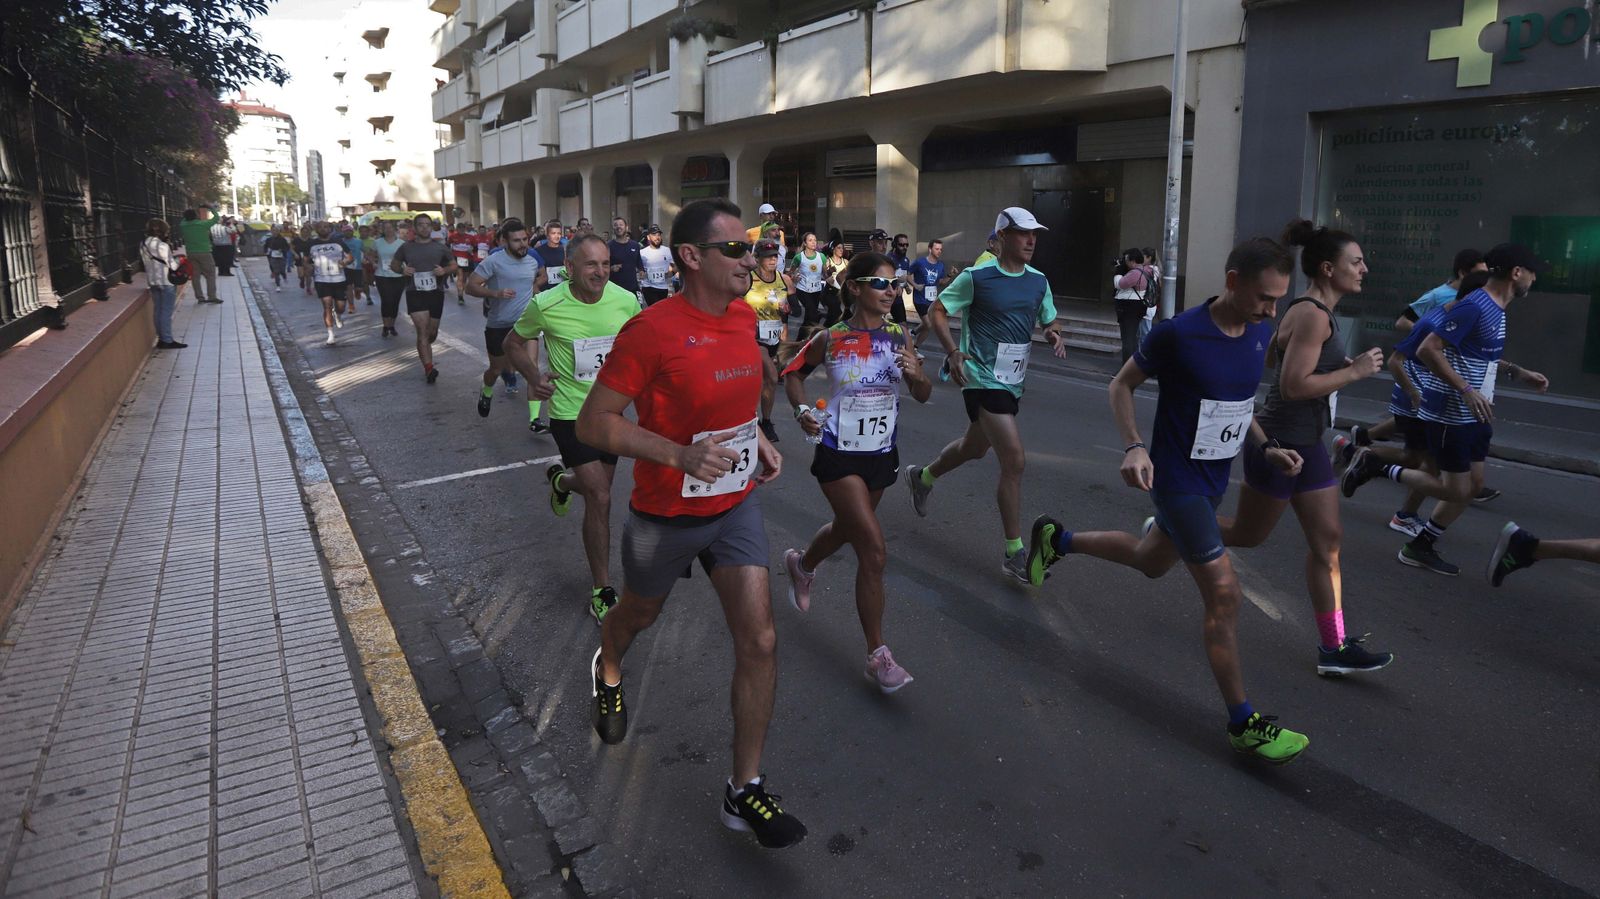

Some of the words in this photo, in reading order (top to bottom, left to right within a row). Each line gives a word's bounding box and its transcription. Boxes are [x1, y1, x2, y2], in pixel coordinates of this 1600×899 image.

[1332, 126, 1435, 150] policlínica
[1441, 124, 1522, 143] europa
[1415, 160, 1470, 174] general
[1420, 176, 1458, 187] todas
[1463, 176, 1484, 187] las
[856, 415, 888, 436] 175
[1220, 422, 1243, 443] 64
